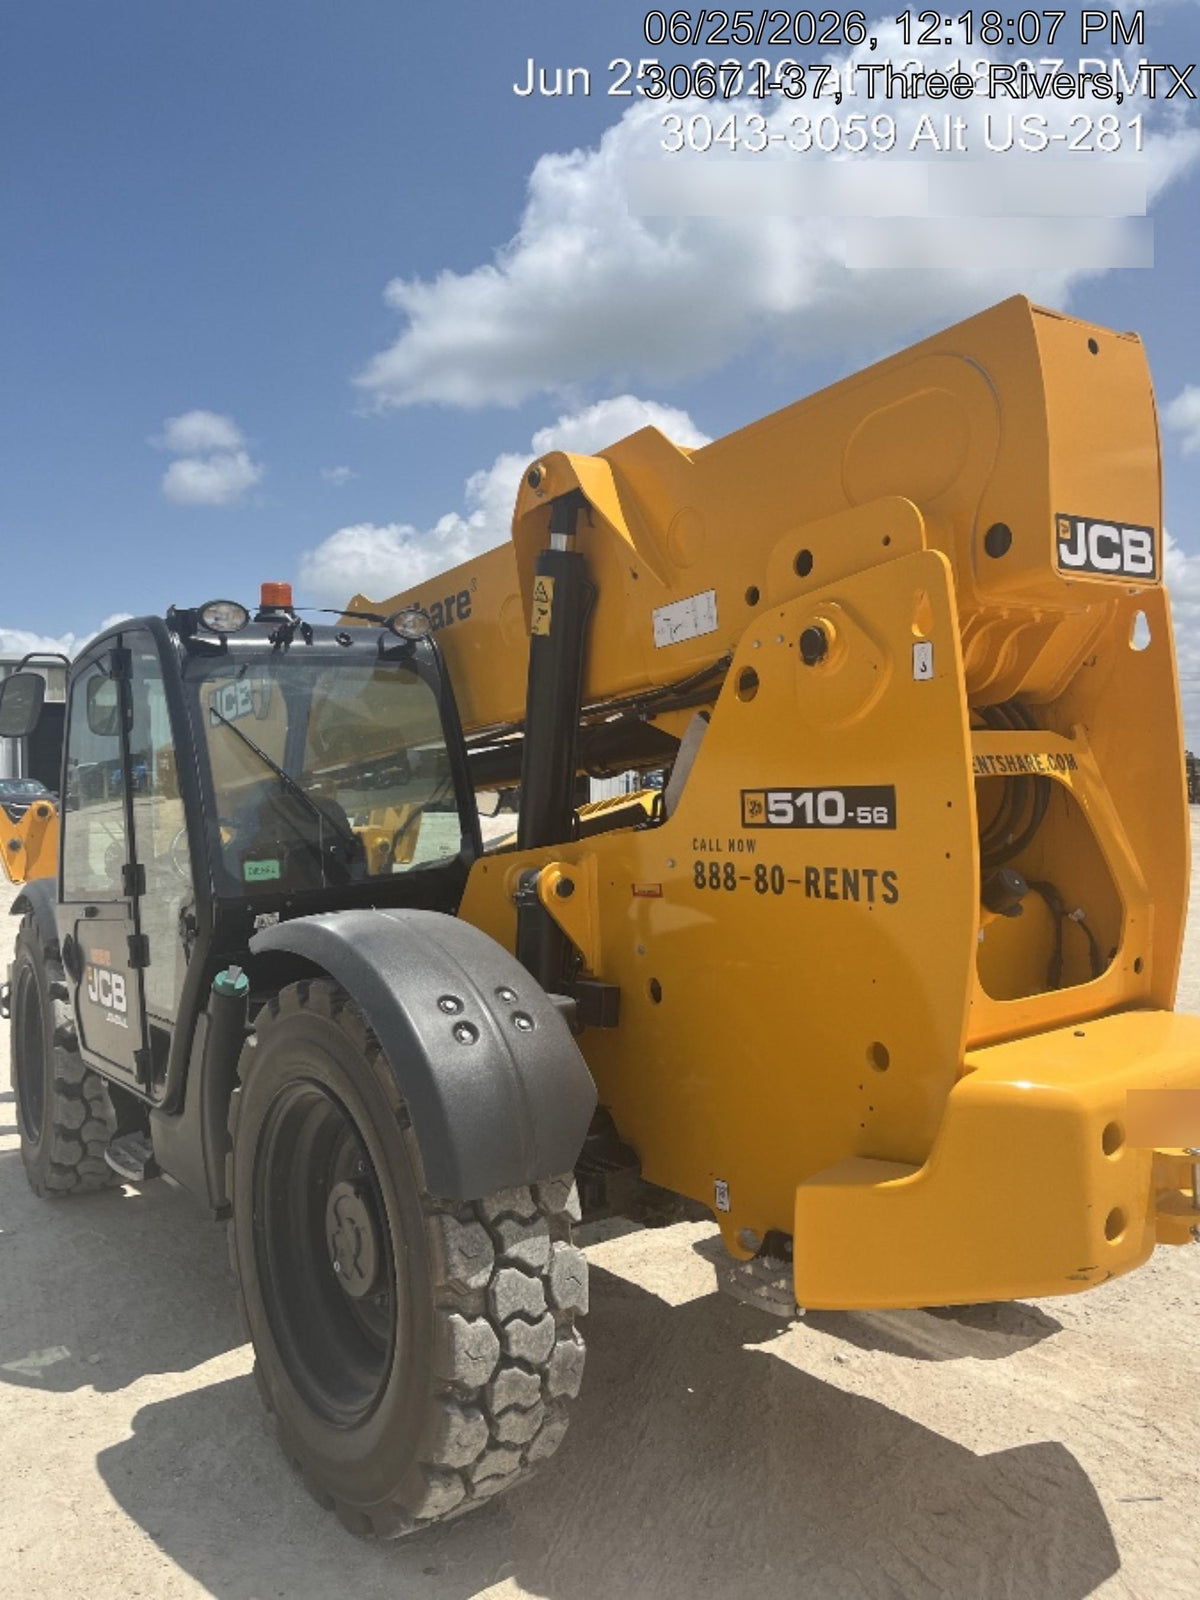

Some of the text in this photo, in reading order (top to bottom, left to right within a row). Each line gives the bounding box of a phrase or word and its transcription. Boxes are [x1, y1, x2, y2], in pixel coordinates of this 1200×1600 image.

[1058, 521, 1154, 574] JCB
[767, 790, 889, 826] 510-56
[692, 837, 757, 853] CALL NOW
[693, 859, 900, 905] 888-80-RENTS
[87, 967, 127, 1013] JCB
